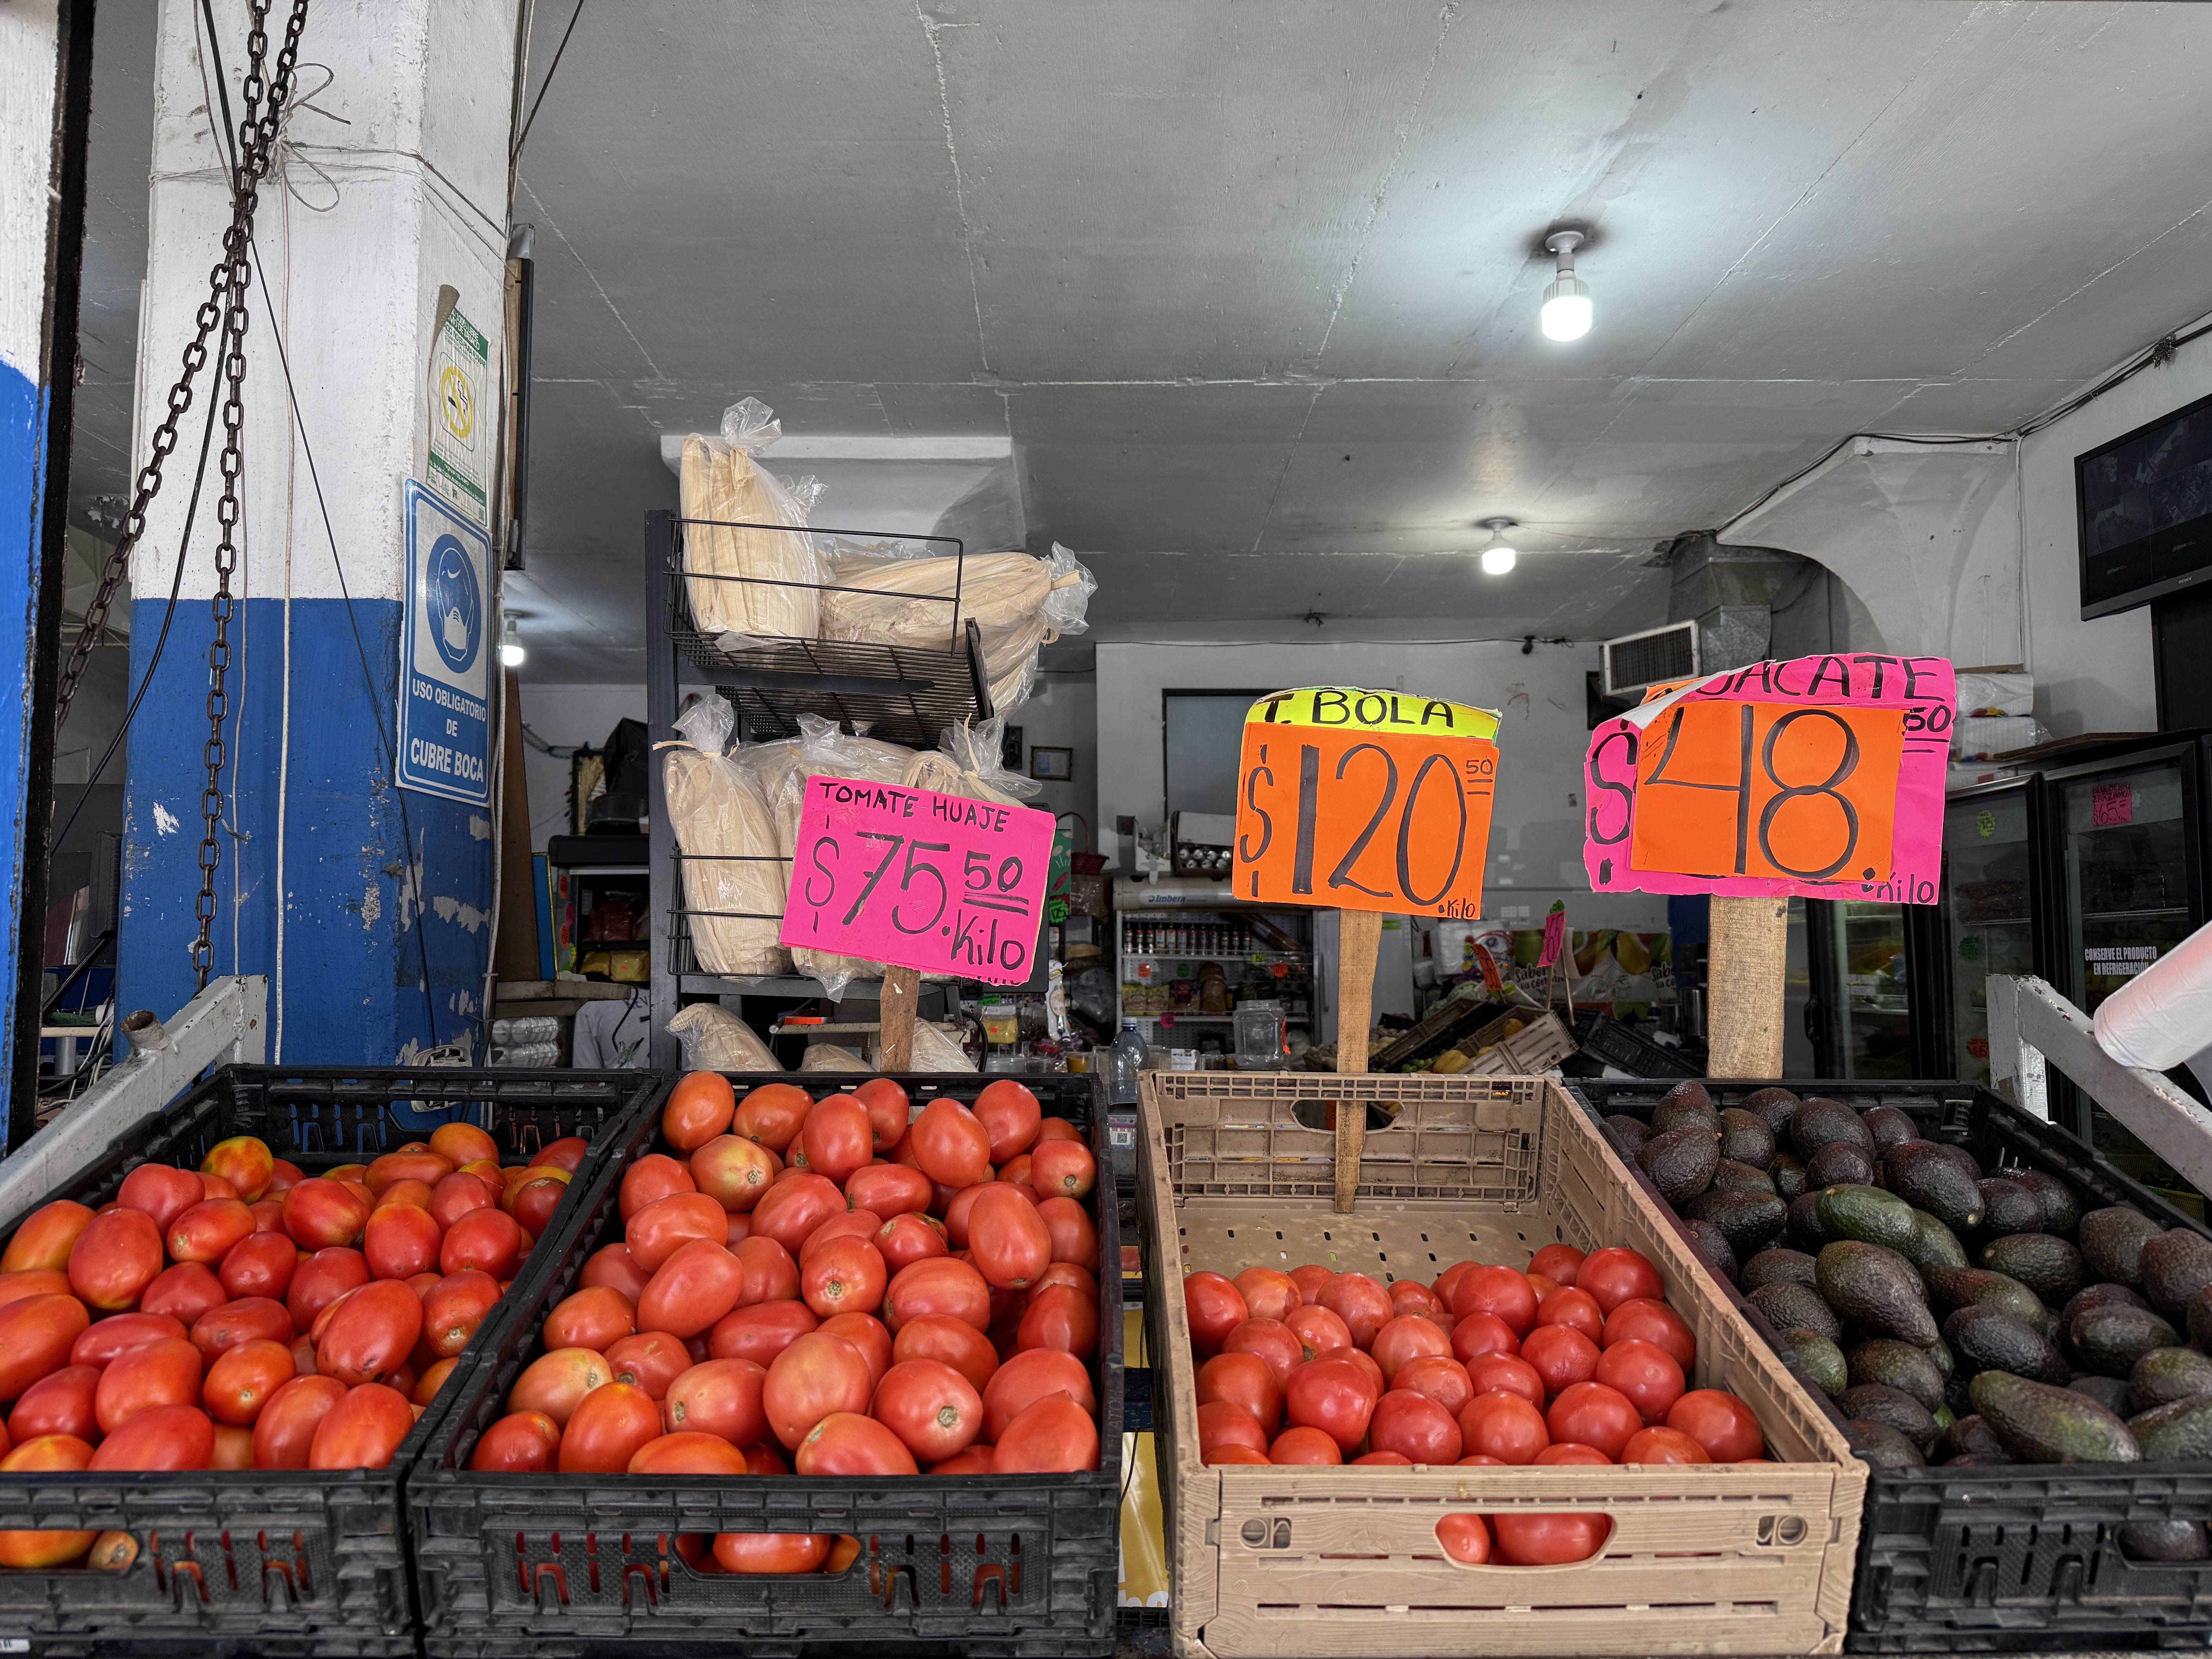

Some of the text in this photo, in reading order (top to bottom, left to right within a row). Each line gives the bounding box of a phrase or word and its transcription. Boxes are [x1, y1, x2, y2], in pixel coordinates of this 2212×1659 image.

[412, 678, 486, 722] USO OBLIGATORIO
[1312, 690, 1454, 728] BOLA
[446, 718, 458, 737] DE
[410, 737, 484, 783] CUBRE BOCA
[1466, 758, 1494, 776] 50
[819, 782, 1011, 833] TOMATE HUAJE
[1155, 895, 1186, 903] Imbera
[2085, 946, 2157, 961] CONSERVE EL PRODUCTO
[2093, 962, 2101, 975] EN
